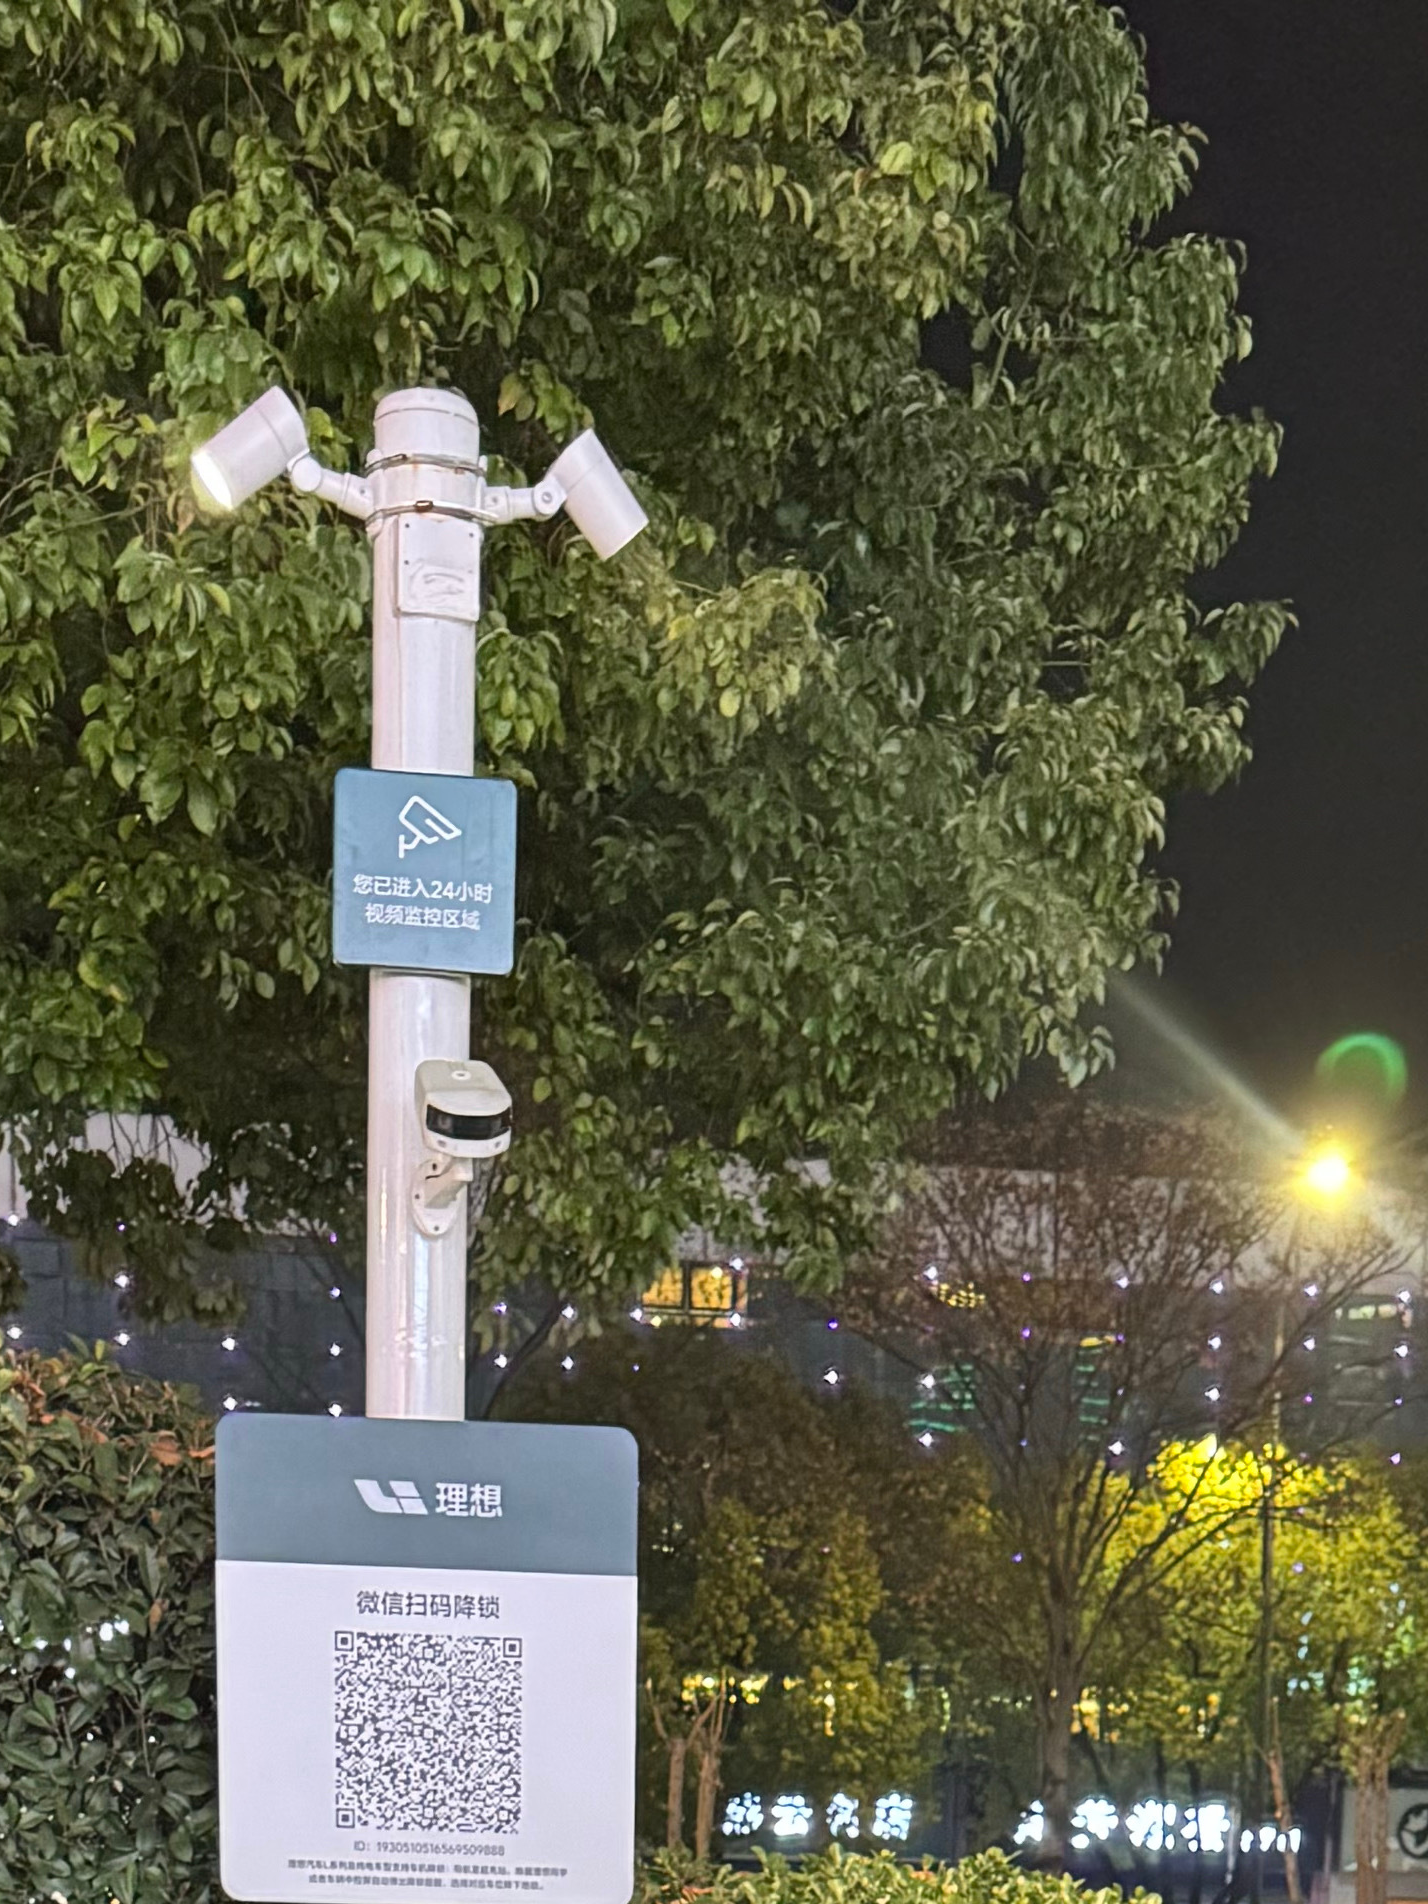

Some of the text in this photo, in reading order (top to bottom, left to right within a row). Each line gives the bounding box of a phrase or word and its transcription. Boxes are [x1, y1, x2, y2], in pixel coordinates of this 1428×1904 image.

[352, 874, 493, 904] 您已进入24小时
[365, 903, 481, 930] 视频监控区域
[435, 1482, 503, 1518] 理想
[356, 1590, 500, 1620] 微信扫码降锁
